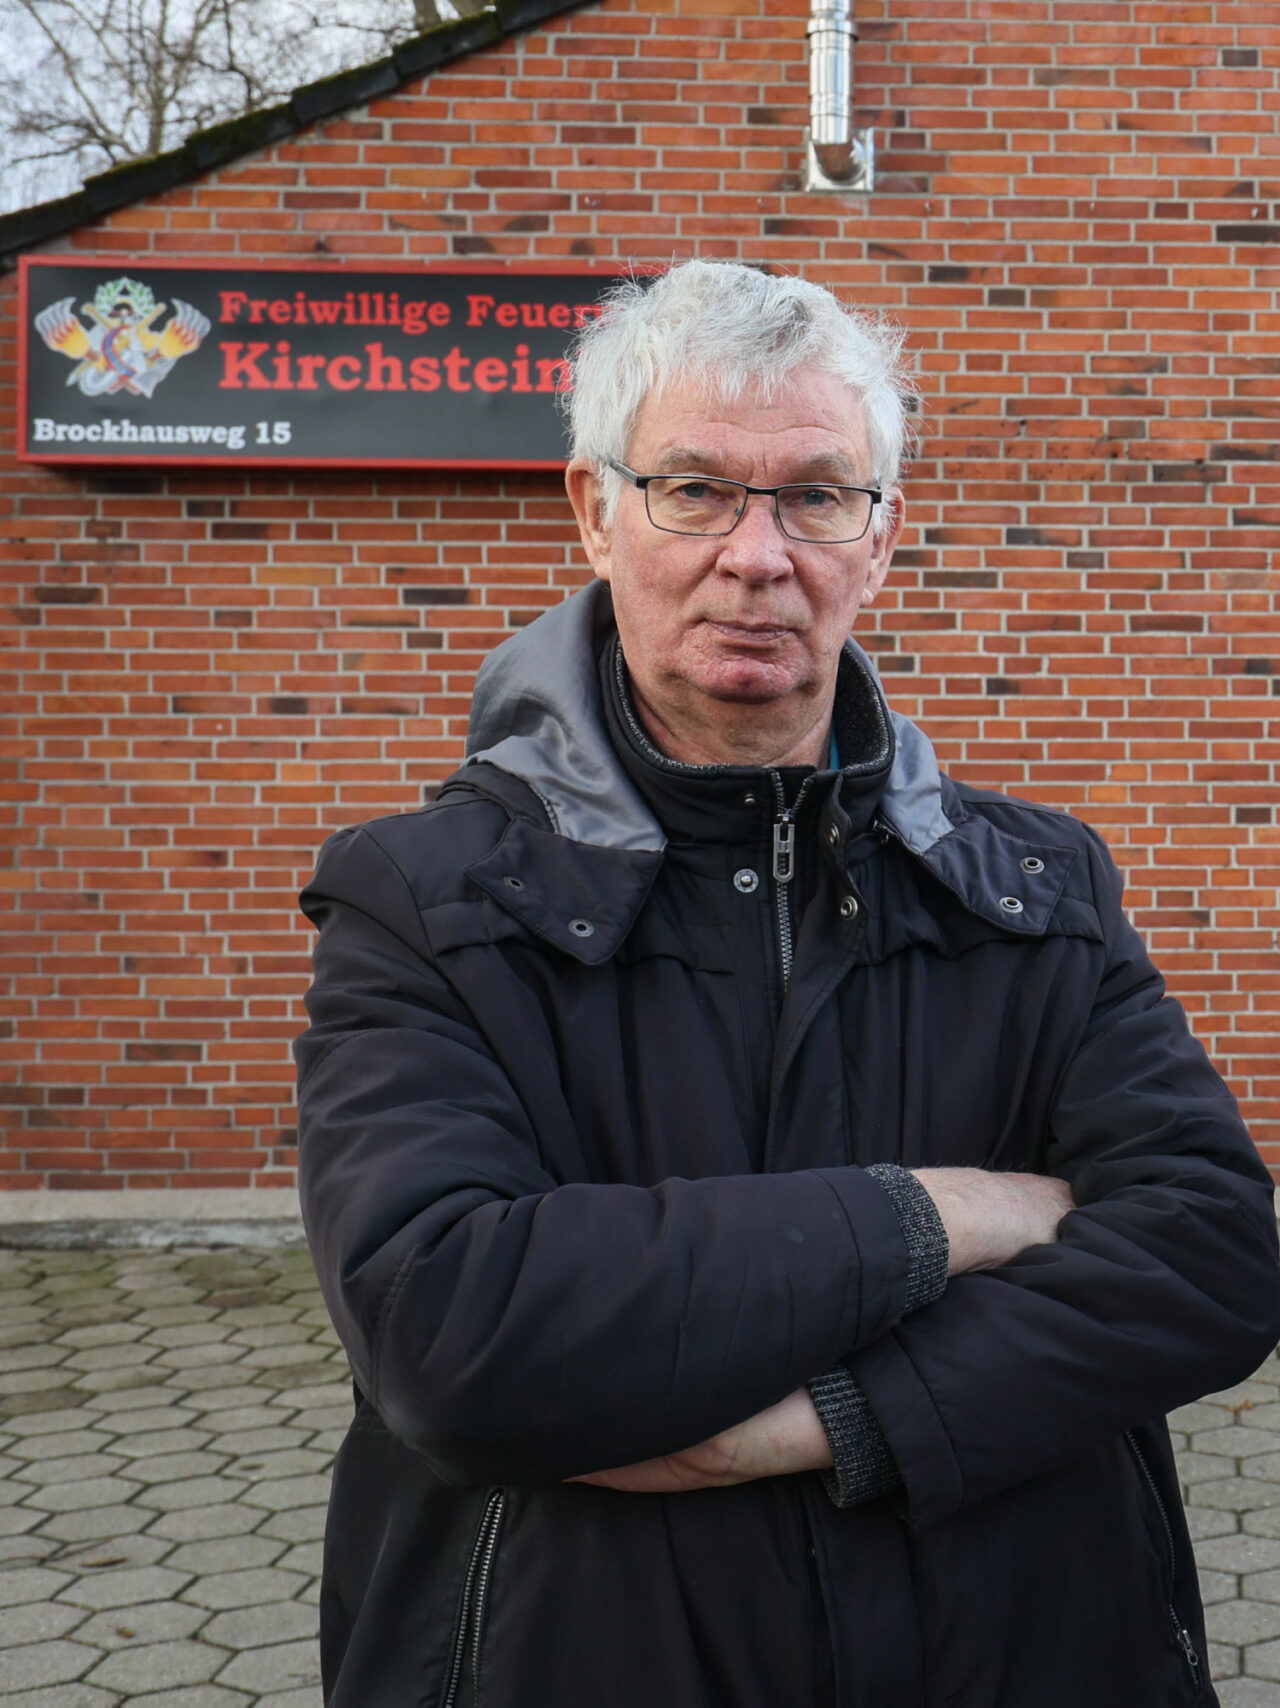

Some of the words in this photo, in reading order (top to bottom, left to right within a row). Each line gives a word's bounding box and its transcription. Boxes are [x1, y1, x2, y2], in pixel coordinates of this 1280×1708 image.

[218, 291, 451, 335] Freiwillige
[465, 294, 610, 328] Feuer
[218, 340, 577, 393] Kirchstein
[33, 418, 246, 449] Brockhausweg
[256, 421, 292, 444] 15
